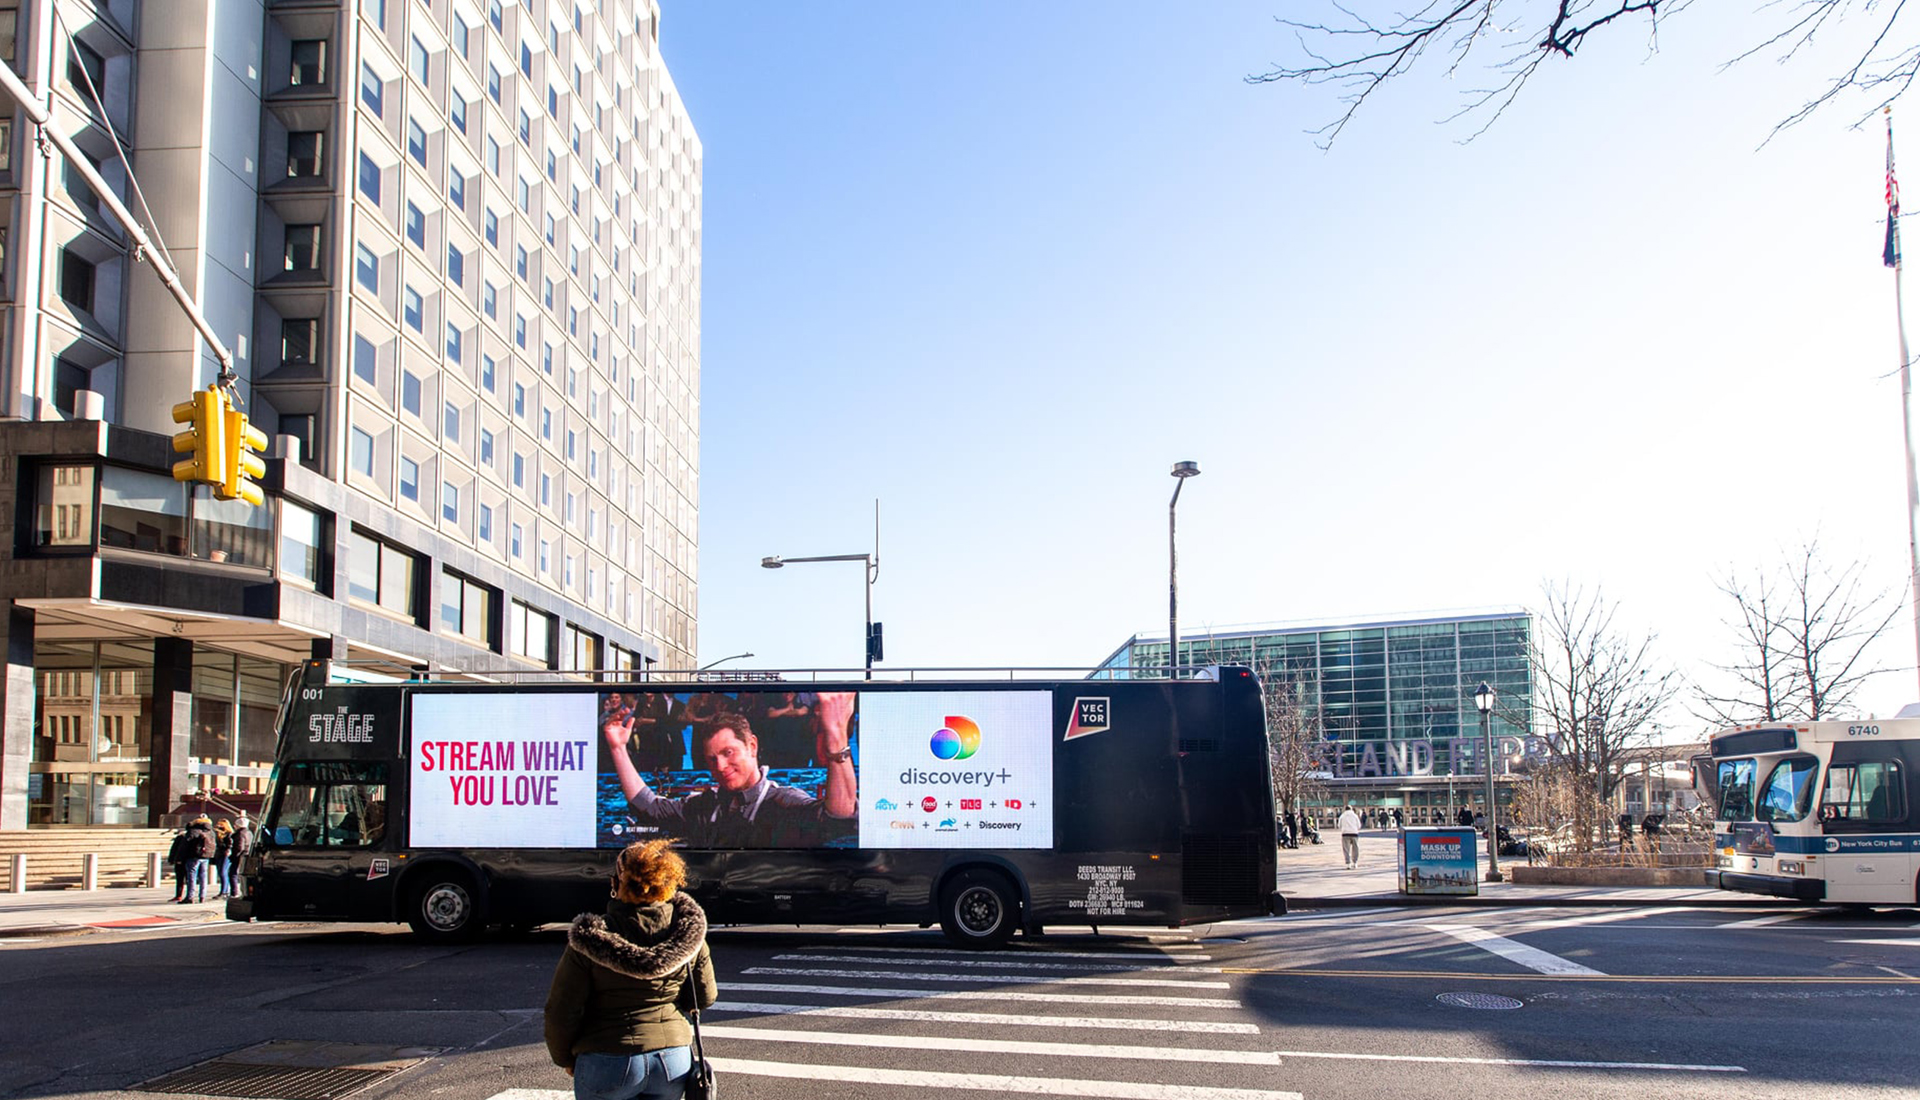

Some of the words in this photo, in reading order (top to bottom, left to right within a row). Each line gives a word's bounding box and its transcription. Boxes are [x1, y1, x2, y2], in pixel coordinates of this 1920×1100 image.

[302, 688, 323, 700] 001
[337, 706, 349, 714] THE
[1082, 704, 1104, 713] VEC
[1082, 714, 1104, 723] TOR
[309, 714, 375, 742] STAGE
[1848, 725, 1880, 736] 6740
[420, 740, 515, 772] STREAM
[522, 741, 588, 771] WHAT
[1303, 740, 1434, 777] SLAND
[899, 767, 1012, 787] discovery+
[450, 775, 494, 806] YOU
[502, 775, 559, 806] LOVE
[875, 801, 898, 811] HGTV
[961, 800, 981, 809] TLC
[979, 820, 1022, 831] Discovery
[1873, 840, 1888, 848] City
[1078, 865, 1097, 873] DEEDS
[1097, 865, 1122, 873] TRANSIT
[1091, 872, 1122, 880] BROADWAY
